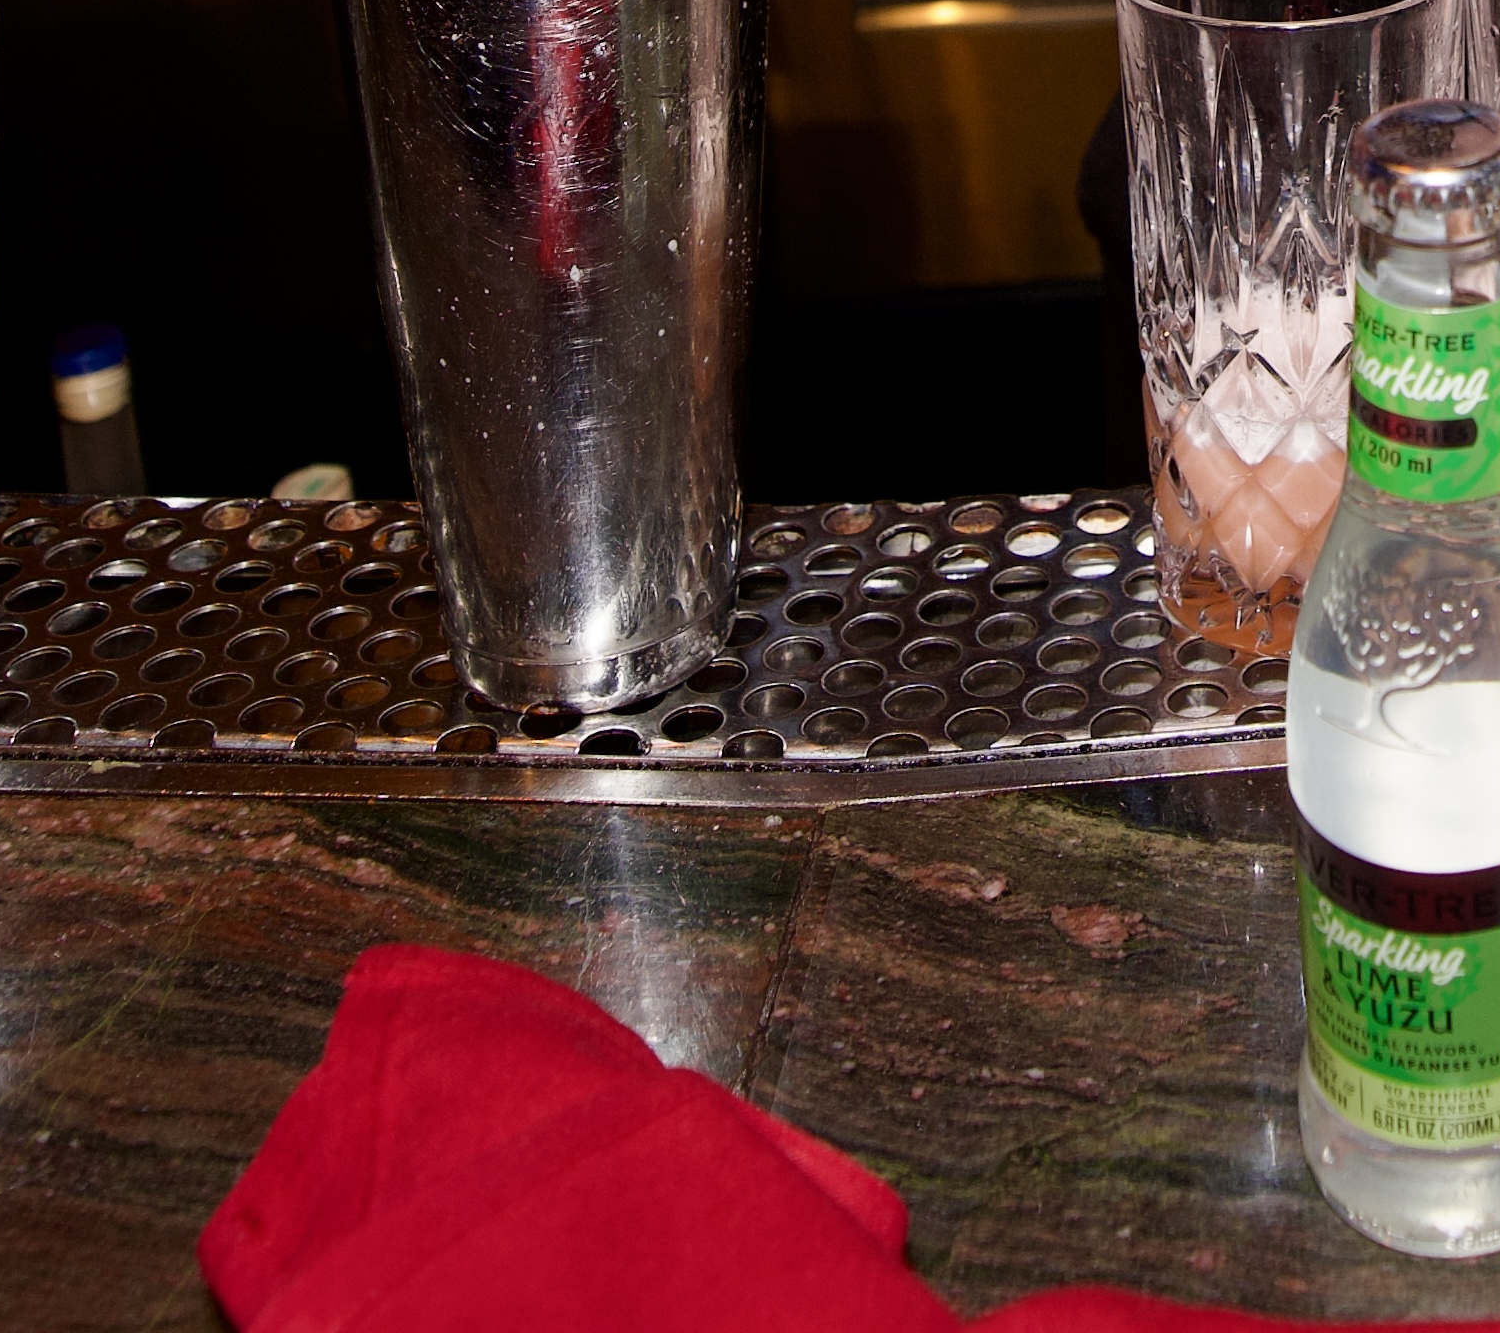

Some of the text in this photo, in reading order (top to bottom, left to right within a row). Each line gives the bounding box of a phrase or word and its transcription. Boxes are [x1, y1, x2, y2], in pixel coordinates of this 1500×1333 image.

[1355, 306, 1476, 353] EVER-TREE
[1368, 440, 1402, 468] 200
[1408, 457, 1433, 475] ml
[1311, 896, 1467, 987] Sparkling
[1337, 949, 1427, 1004] LIME
[1348, 984, 1454, 1035] YUZU
[1389, 1057, 1471, 1074] JAPANESE
[1386, 1098, 1487, 1115] SWEETENERS
[1408, 1087, 1494, 1102] ARTIFICIAL
[1397, 1117, 1413, 1134] FL
[1416, 1120, 1436, 1139] OZ
